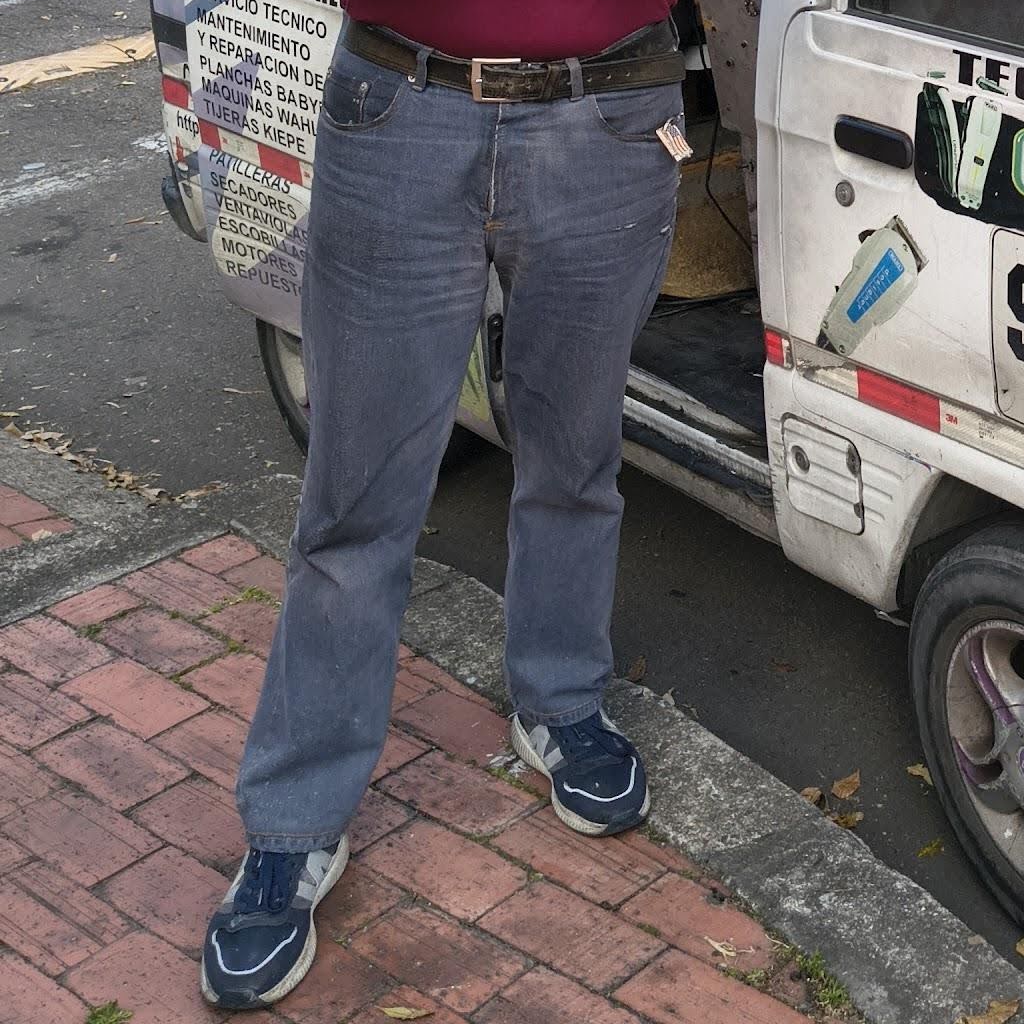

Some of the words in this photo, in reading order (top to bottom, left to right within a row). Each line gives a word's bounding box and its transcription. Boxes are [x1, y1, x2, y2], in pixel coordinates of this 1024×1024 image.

[197, 7, 311, 61] MANTENIMIENTO
[263, 2, 327, 39] TECNICO
[197, 29, 206, 46] Y
[209, 34, 299, 82] REPARACION
[304, 69, 324, 91] DE
[199, 55, 273, 97] PLANCHAS
[201, 76, 273, 118] MAQUINAS
[277, 106, 317, 137] WAHL
[203, 98, 259, 135] TIJERAS
[263, 123, 306, 155] KIEPE
[209, 149, 293, 194] PATILLERAS
[211, 171, 297, 221] SECADORES
[219, 216, 307, 263] ESCOBILLAS
[222, 238, 298, 277] MOTORES
[226, 260, 300, 297] REPUEST
[945, 413, 958, 425] 3M
